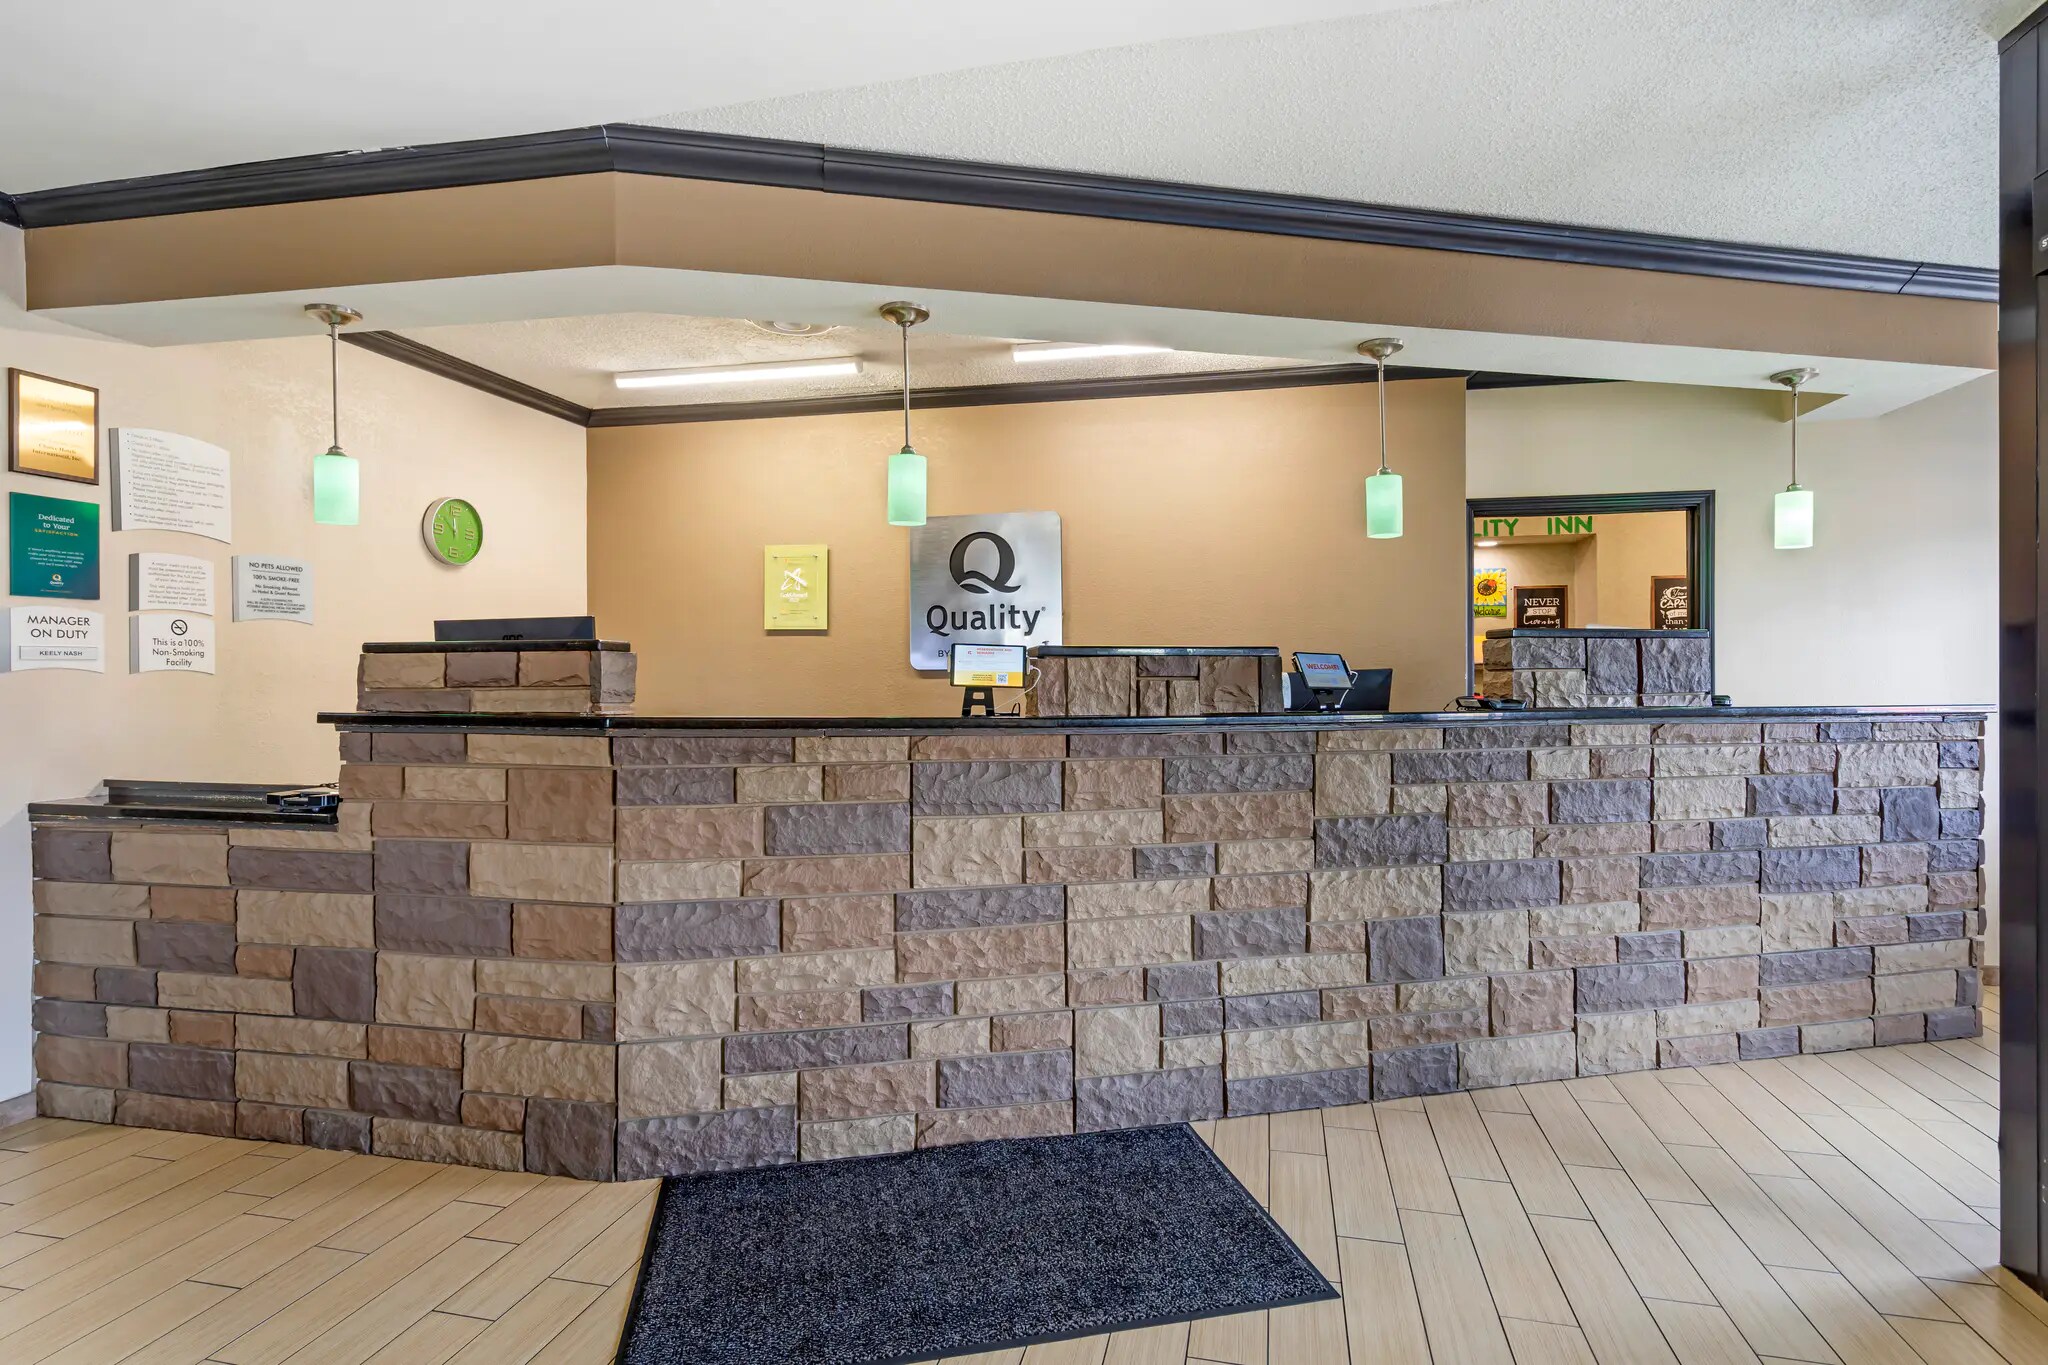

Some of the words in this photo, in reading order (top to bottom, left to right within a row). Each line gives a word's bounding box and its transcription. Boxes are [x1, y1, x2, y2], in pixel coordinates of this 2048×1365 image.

[38, 513, 75, 524] Dedicated
[1547, 515, 1593, 536] INN
[34, 528, 79, 537] SATISFACTION
[1523, 598, 1560, 607] NEVER
[1660, 599, 1688, 609] CAPA
[27, 614, 91, 626] MANAGER
[926, 603, 1041, 637] Quality
[30, 628, 52, 638] ON
[56, 629, 88, 639] DUTY
[152, 638, 168, 646] This
[184, 639, 205, 647] 100%
[152, 648, 205, 658] Non-Smoking
[166, 658, 192, 668] Facility
